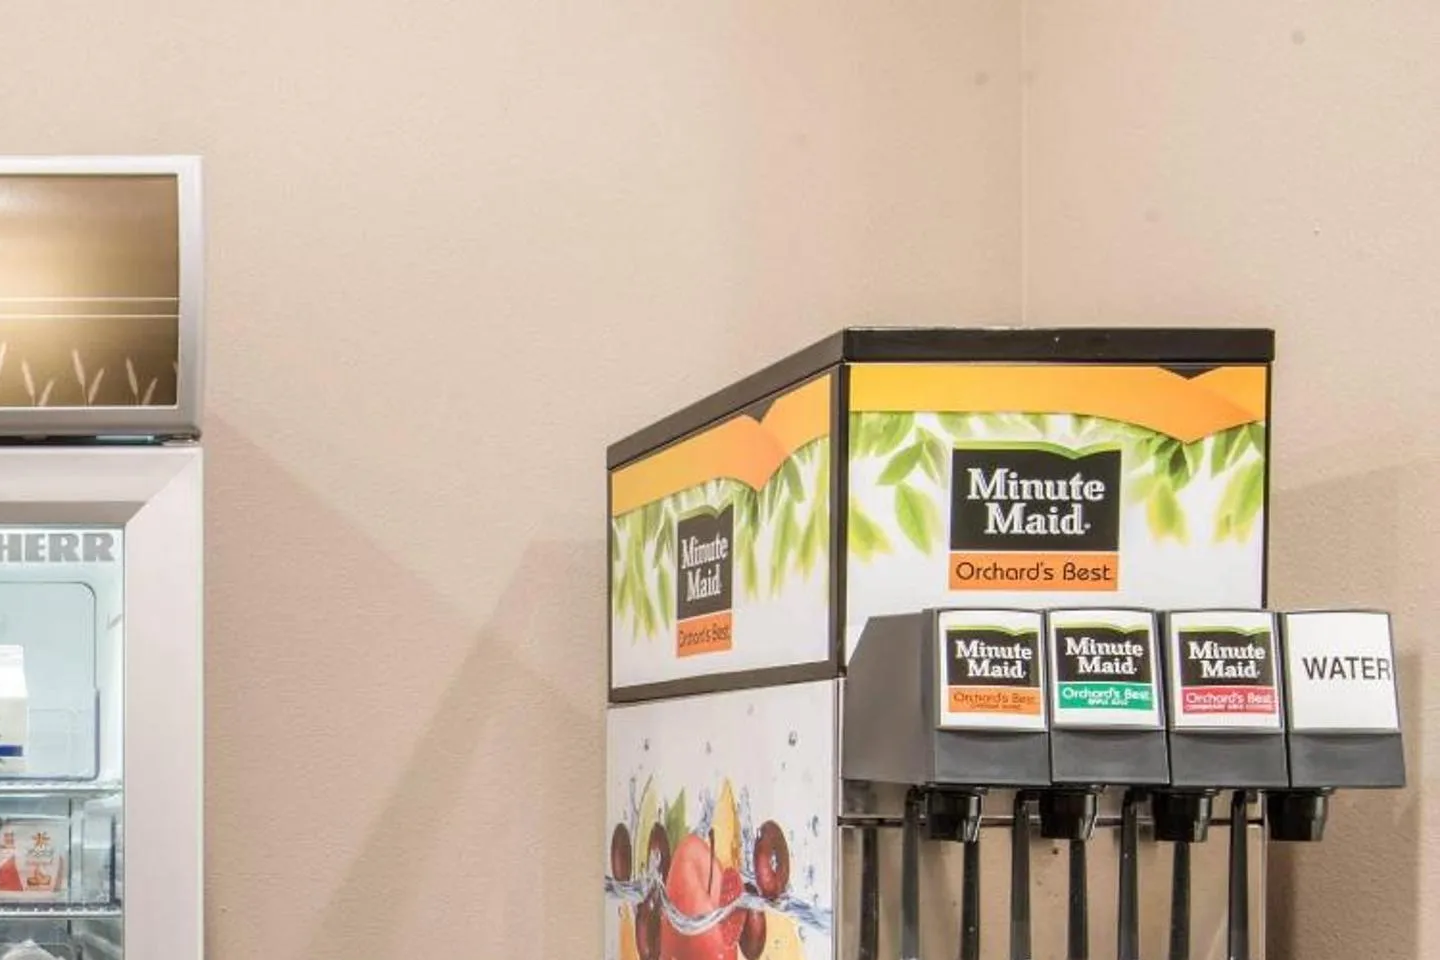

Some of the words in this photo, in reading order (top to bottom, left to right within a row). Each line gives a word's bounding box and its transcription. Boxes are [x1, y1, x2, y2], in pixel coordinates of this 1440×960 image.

[965, 467, 1107, 502] Minute
[983, 502, 1087, 535] Maid
[680, 531, 729, 570] Minute
[955, 561, 1055, 581] Orchard's
[1063, 562, 1112, 581] Best
[686, 563, 722, 602] Maid
[954, 639, 1033, 661] Minute
[1064, 636, 1145, 658] Minute
[1187, 640, 1267, 660] Minute
[967, 658, 1027, 679] Maid
[1077, 655, 1137, 675] Maid
[1200, 659, 1261, 679] Maid
[1302, 655, 1391, 681] WATER
[1062, 686, 1121, 700] Orchard's
[1185, 691, 1246, 704] Orchard's
